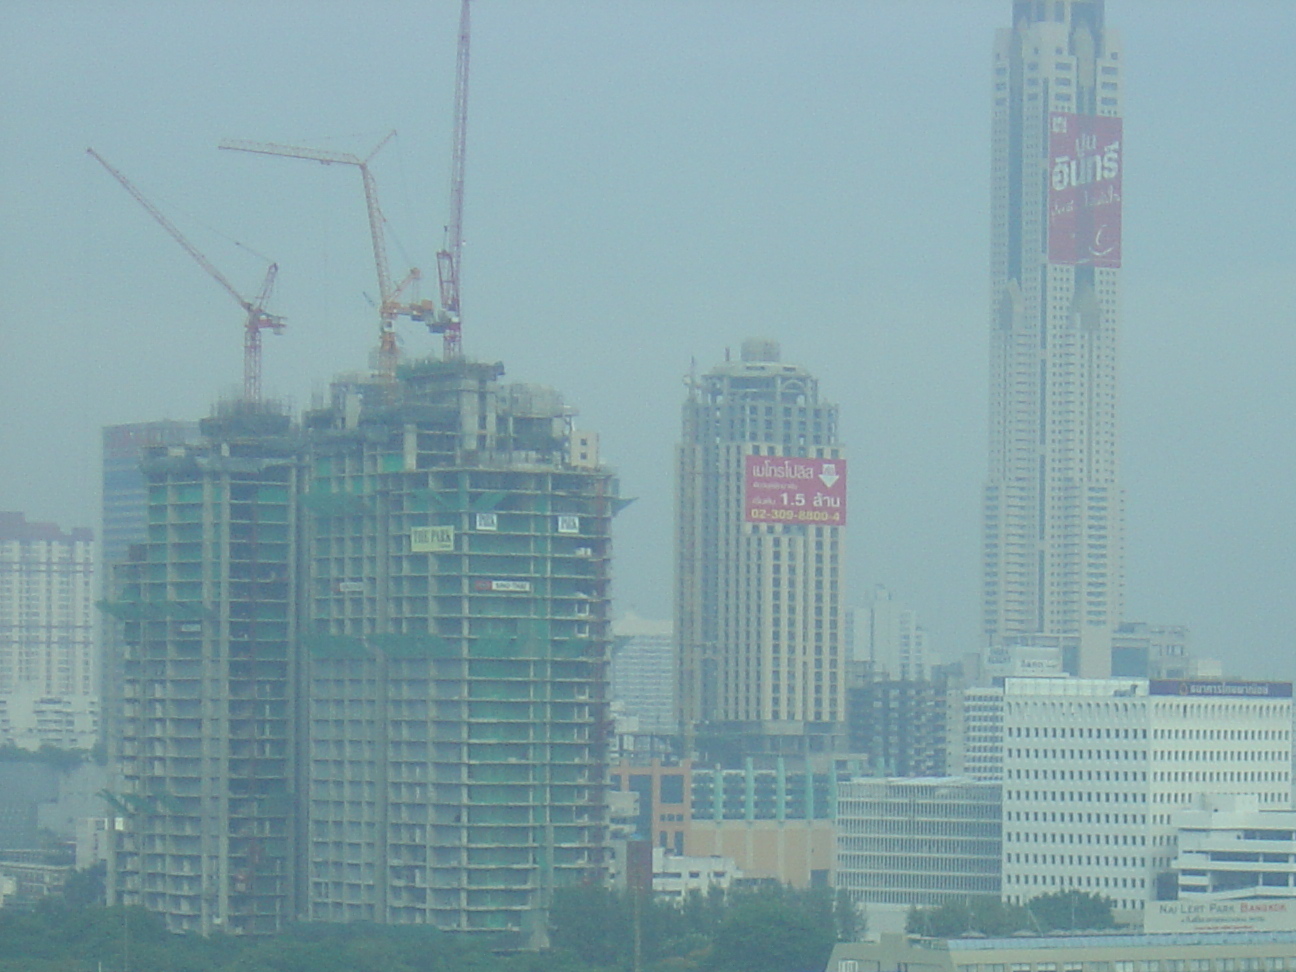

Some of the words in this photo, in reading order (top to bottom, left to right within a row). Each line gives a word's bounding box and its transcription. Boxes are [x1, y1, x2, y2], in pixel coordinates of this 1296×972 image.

[1051, 140, 1120, 191] อินทรี
[780, 492, 806, 506] 1.5
[812, 491, 840, 507] ล้าน
